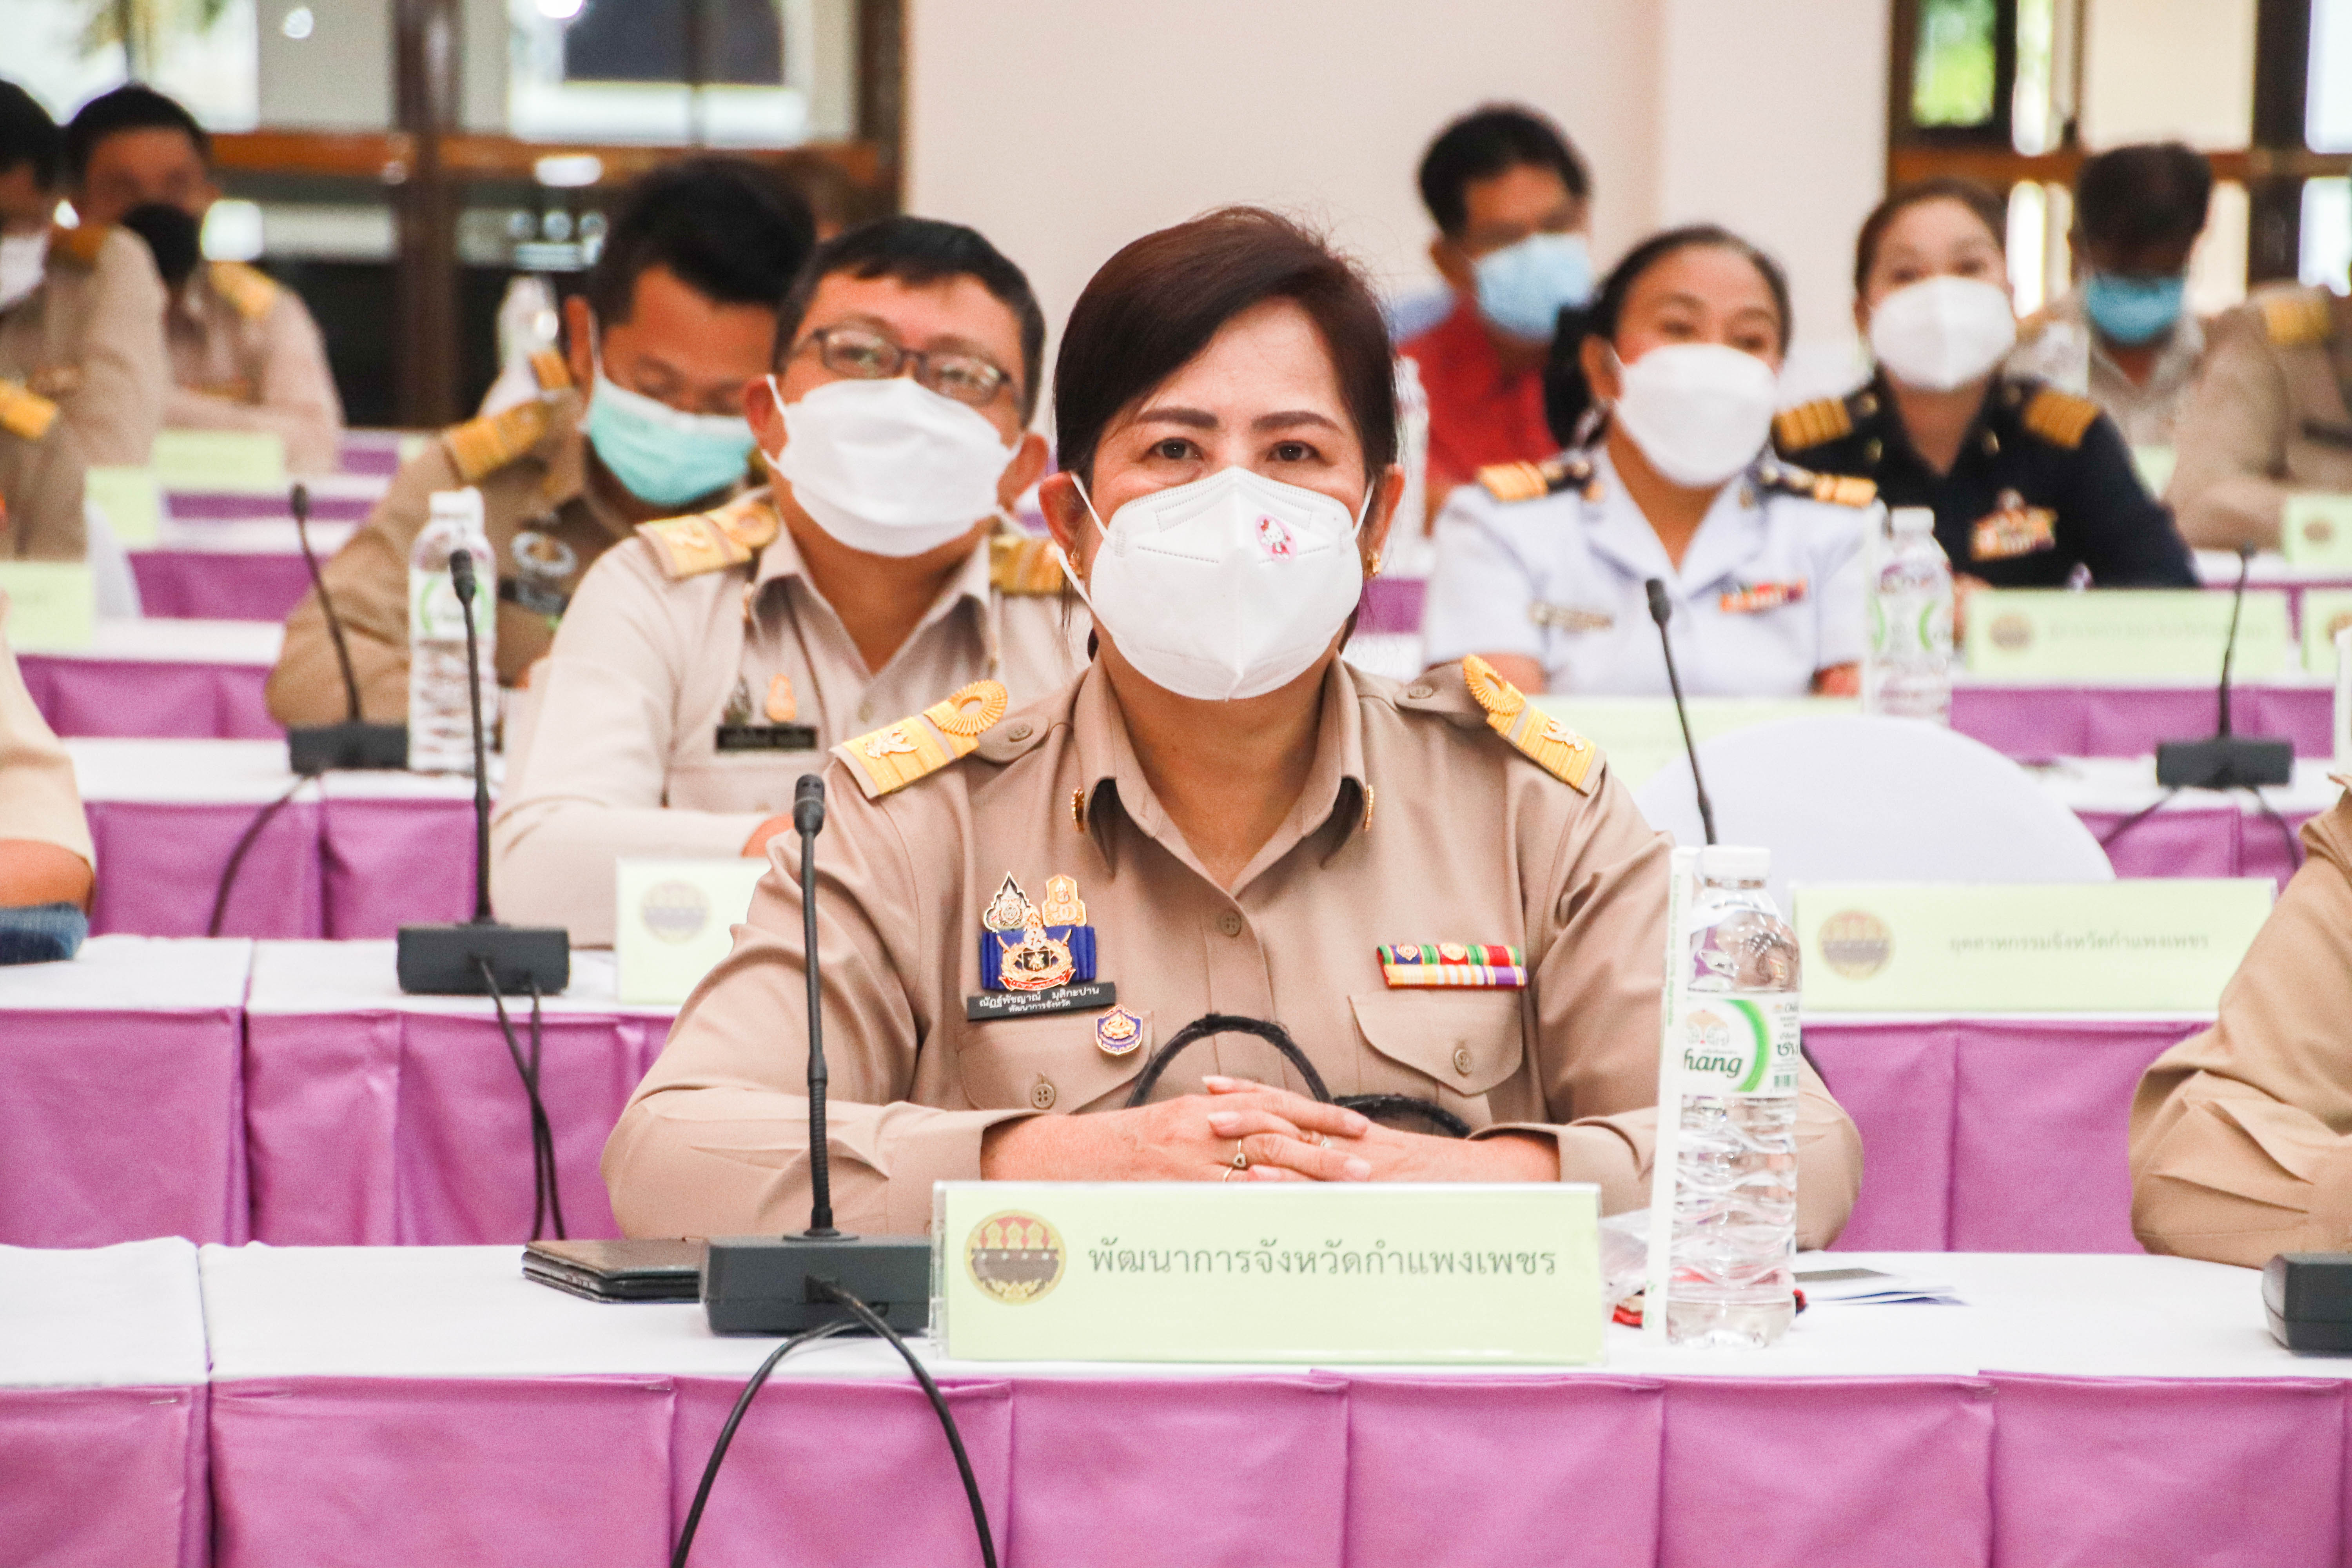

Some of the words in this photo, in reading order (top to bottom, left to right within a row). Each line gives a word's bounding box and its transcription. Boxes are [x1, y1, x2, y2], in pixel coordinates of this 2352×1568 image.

[1008, 999, 1071, 1013] พัฒนาการจังหวัด
[1684, 1048, 1743, 1078] hang
[1088, 1236, 1555, 1276] พัฒนาการจังหวัดกำแพงเพชร
